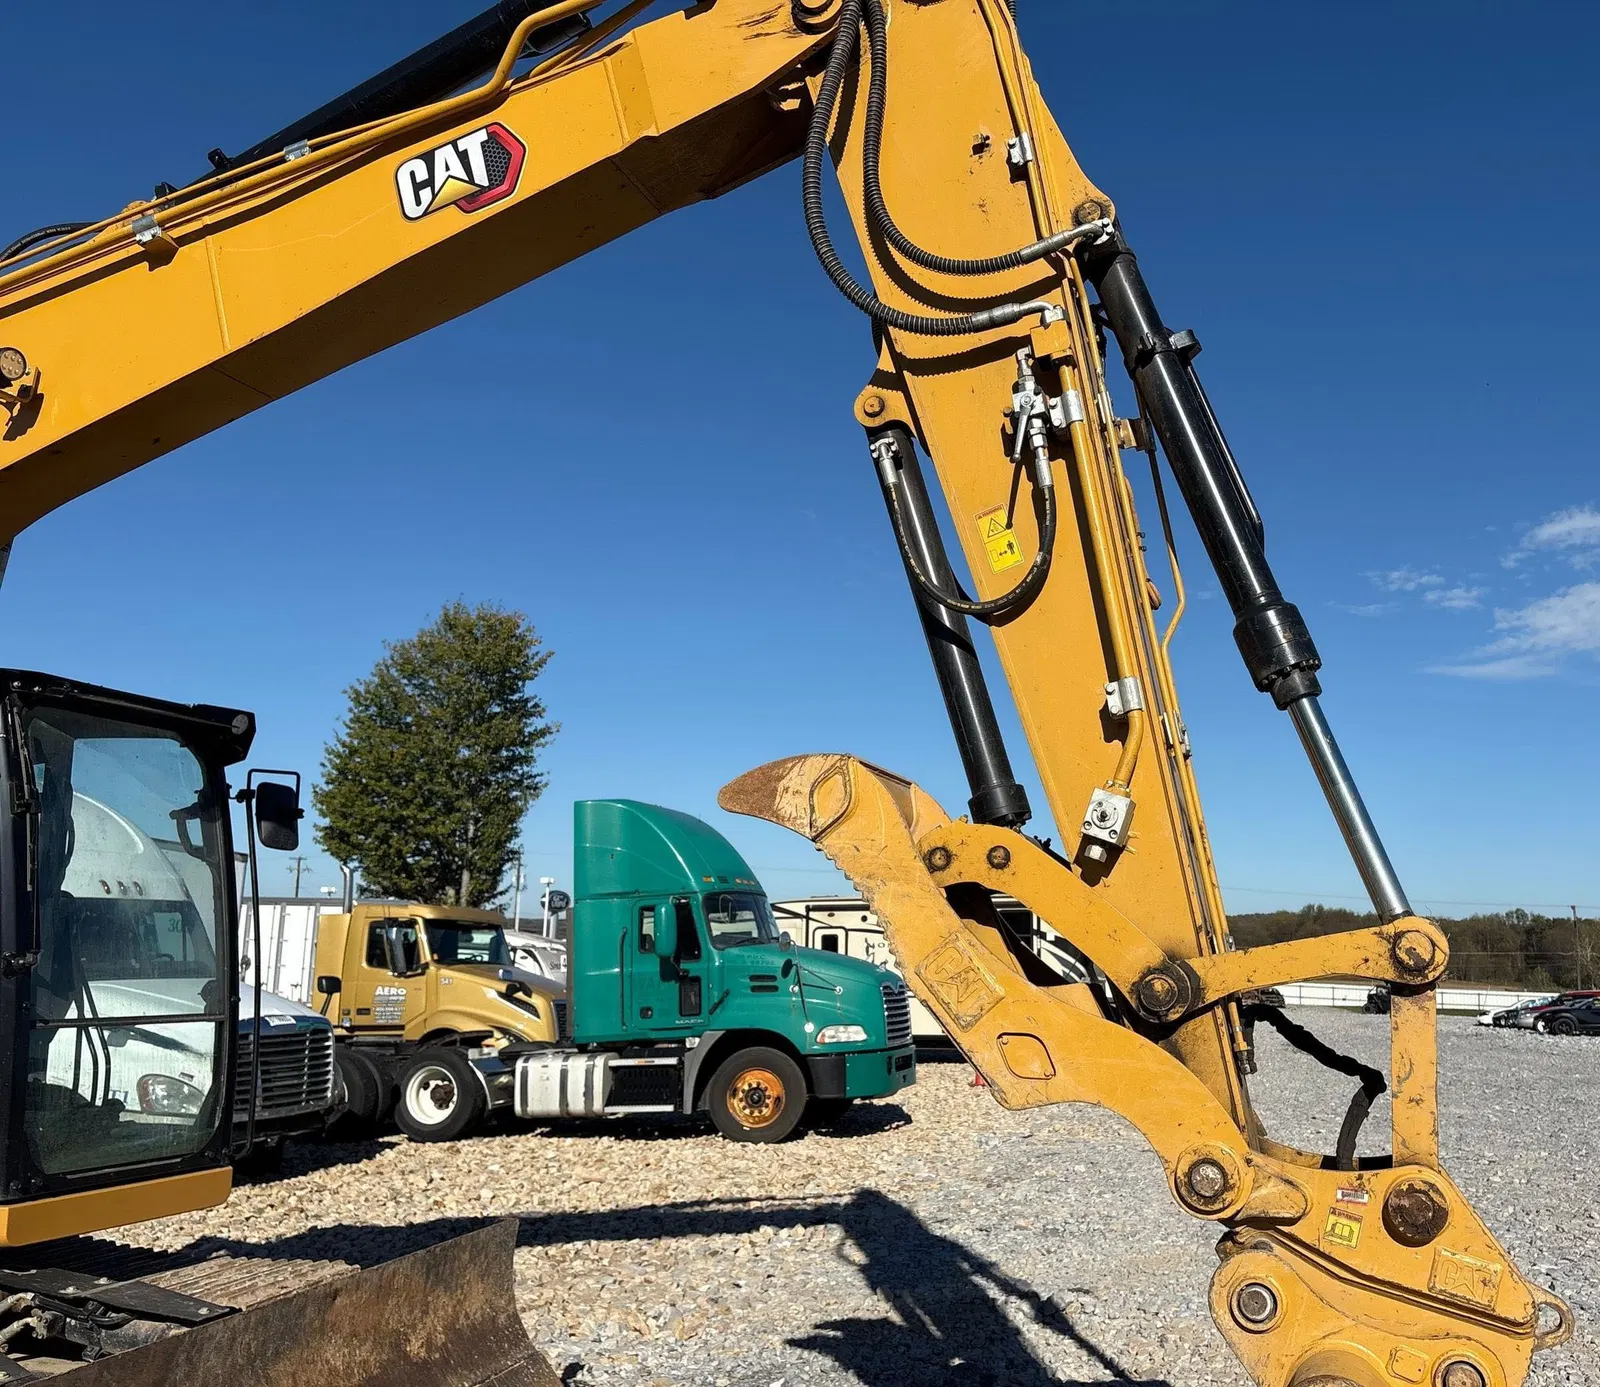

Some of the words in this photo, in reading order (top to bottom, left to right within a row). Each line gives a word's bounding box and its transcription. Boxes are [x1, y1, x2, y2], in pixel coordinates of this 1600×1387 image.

[396, 127, 490, 219] CAT
[375, 985, 407, 995] AERO
[926, 946, 993, 1003] CAT
[1440, 1259, 1493, 1301] CAT
